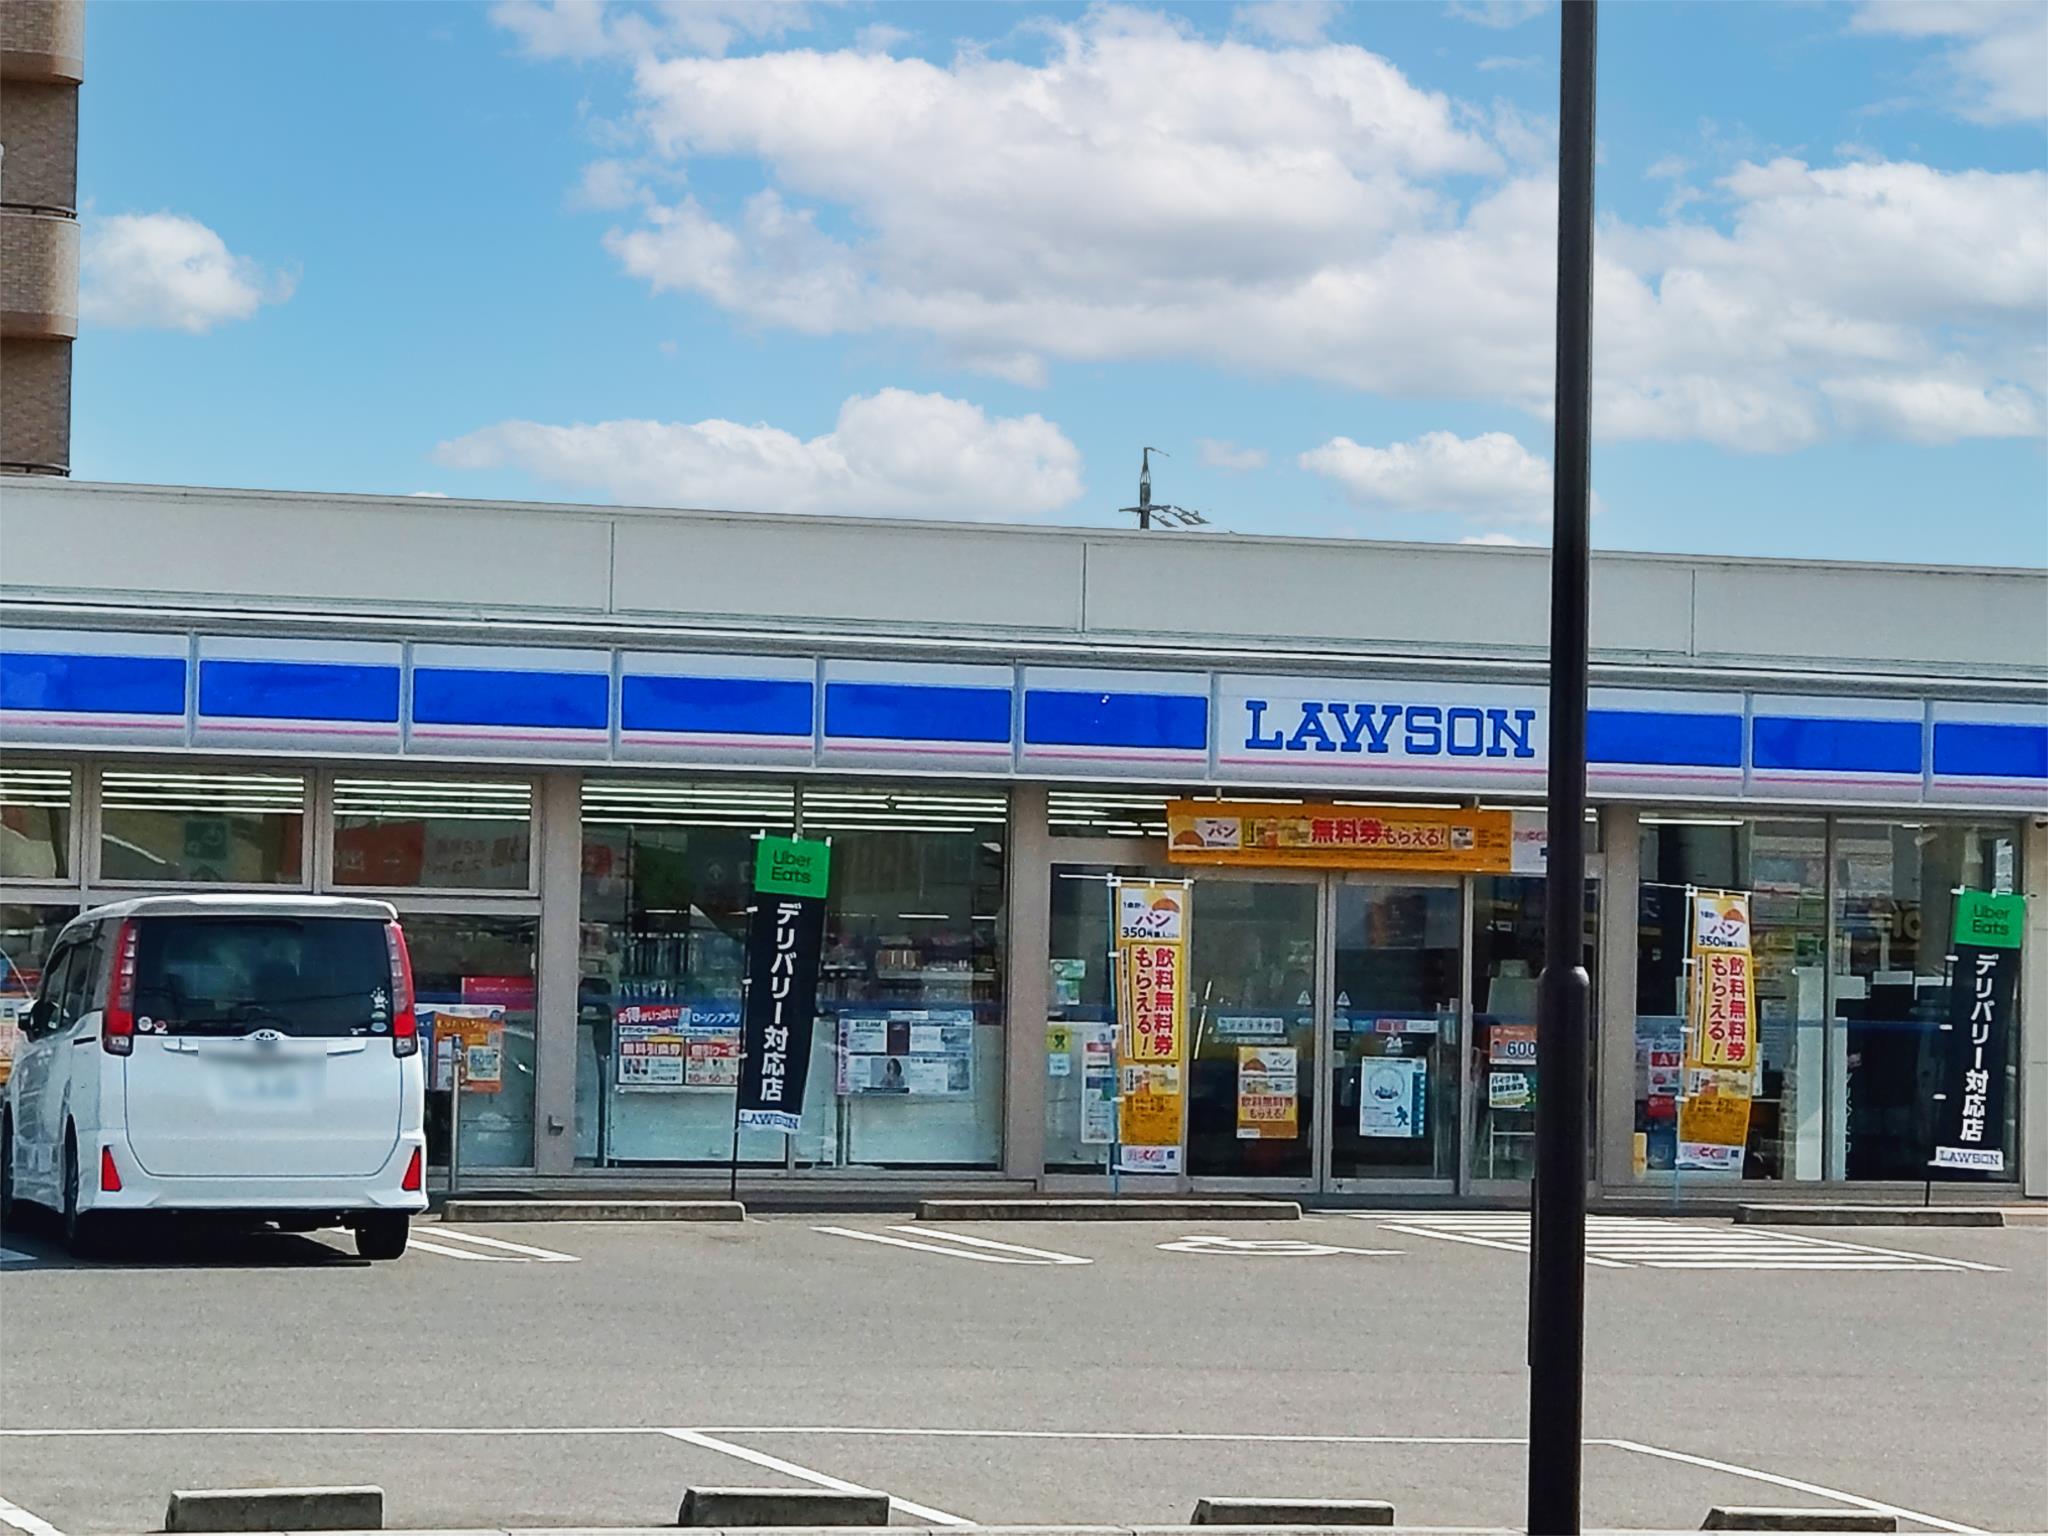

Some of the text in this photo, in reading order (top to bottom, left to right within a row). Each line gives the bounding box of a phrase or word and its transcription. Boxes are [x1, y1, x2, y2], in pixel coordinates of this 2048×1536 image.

[1245, 700, 1536, 757] LAWSON
[771, 866, 812, 884] Eats
[773, 849, 812, 867] Uber
[1135, 911, 1171, 929] パン
[1710, 921, 1740, 937] パン
[1971, 919, 2010, 937] Eats
[1973, 903, 2010, 920] Uber
[760, 902, 802, 1101] デリバリー対応店
[1136, 947, 1153, 1056] もらえる!
[1154, 947, 1175, 1055] 飲料無料券
[1709, 957, 1727, 1061] もらえる!
[1728, 957, 1746, 1061] 飲料無料券
[1960, 953, 1999, 1142] デリバリー対応店
[1940, 1150, 1999, 1165] LAWSON
